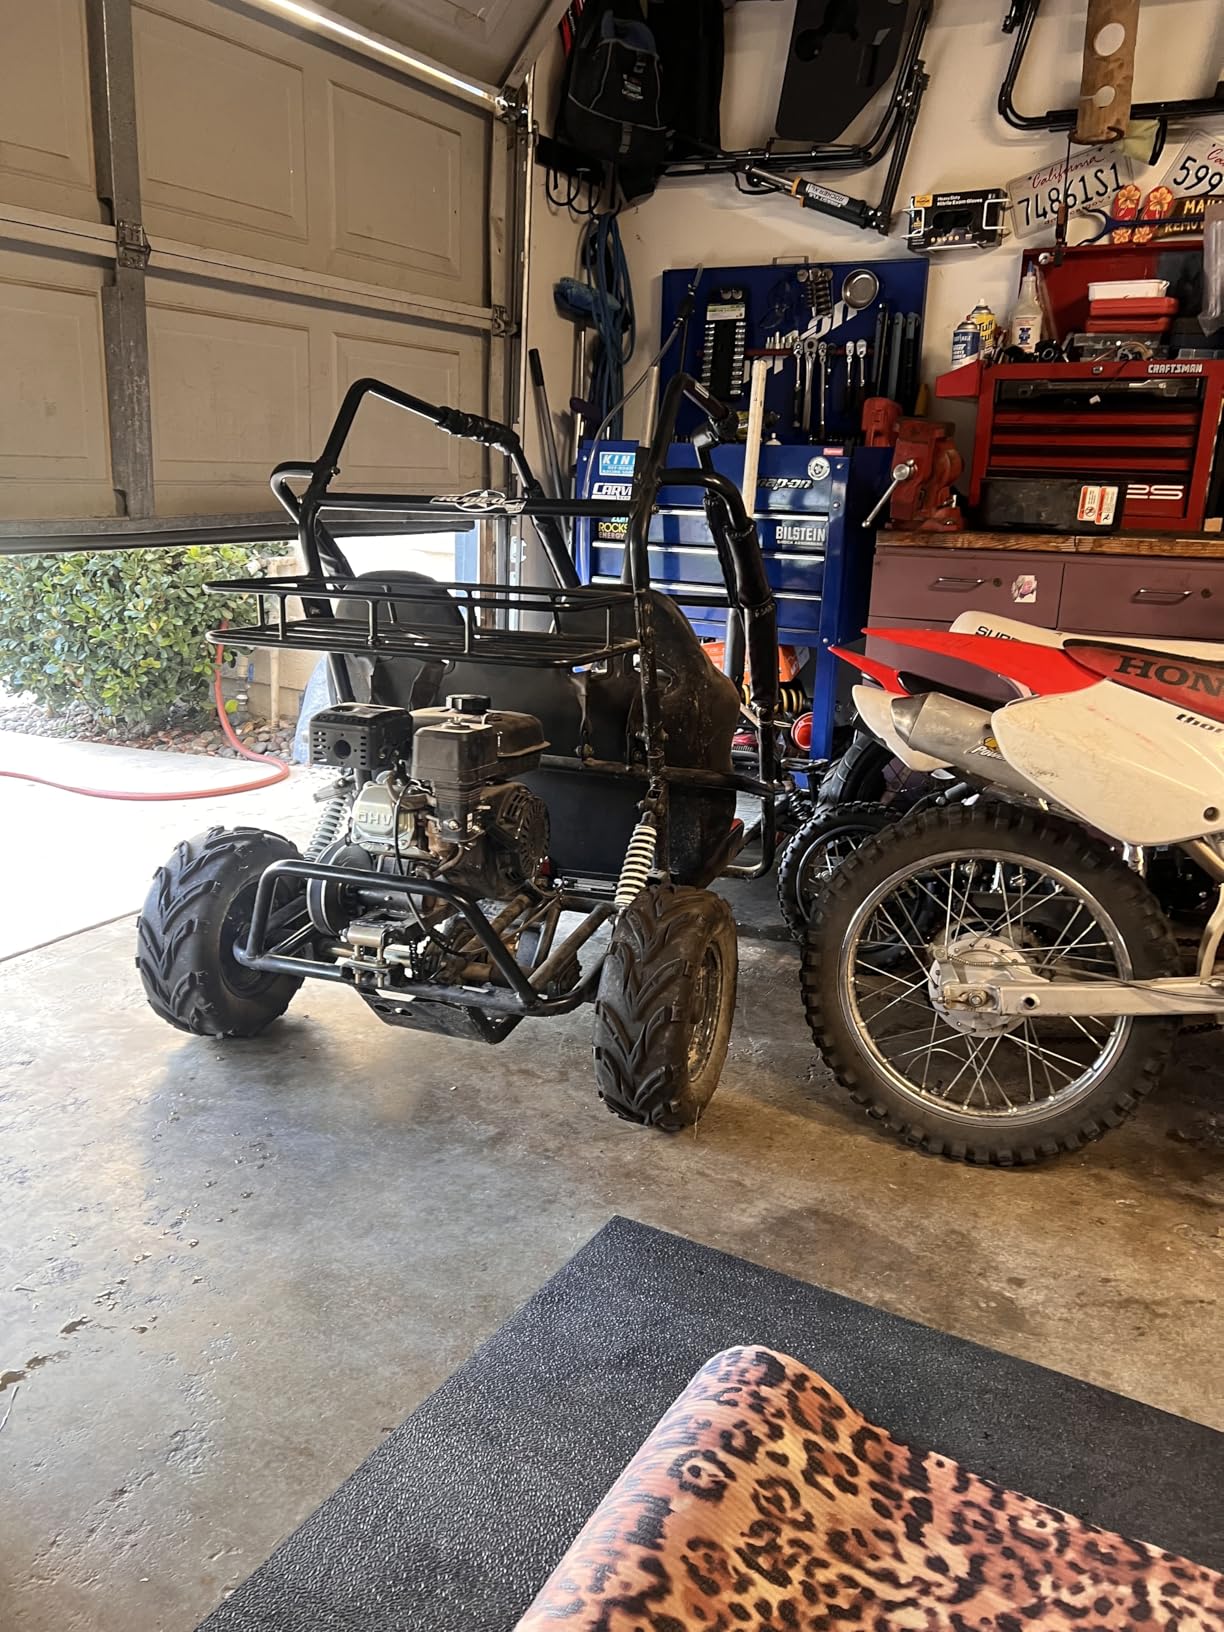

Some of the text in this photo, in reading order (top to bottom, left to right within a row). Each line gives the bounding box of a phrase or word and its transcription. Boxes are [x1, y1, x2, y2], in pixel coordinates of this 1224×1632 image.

[1018, 162, 1125, 226] 74861S1
[1148, 363, 1203, 374] CRAFTSMAN
[775, 526, 826, 542] BILSTEIN
[358, 811, 393, 825] OHV
